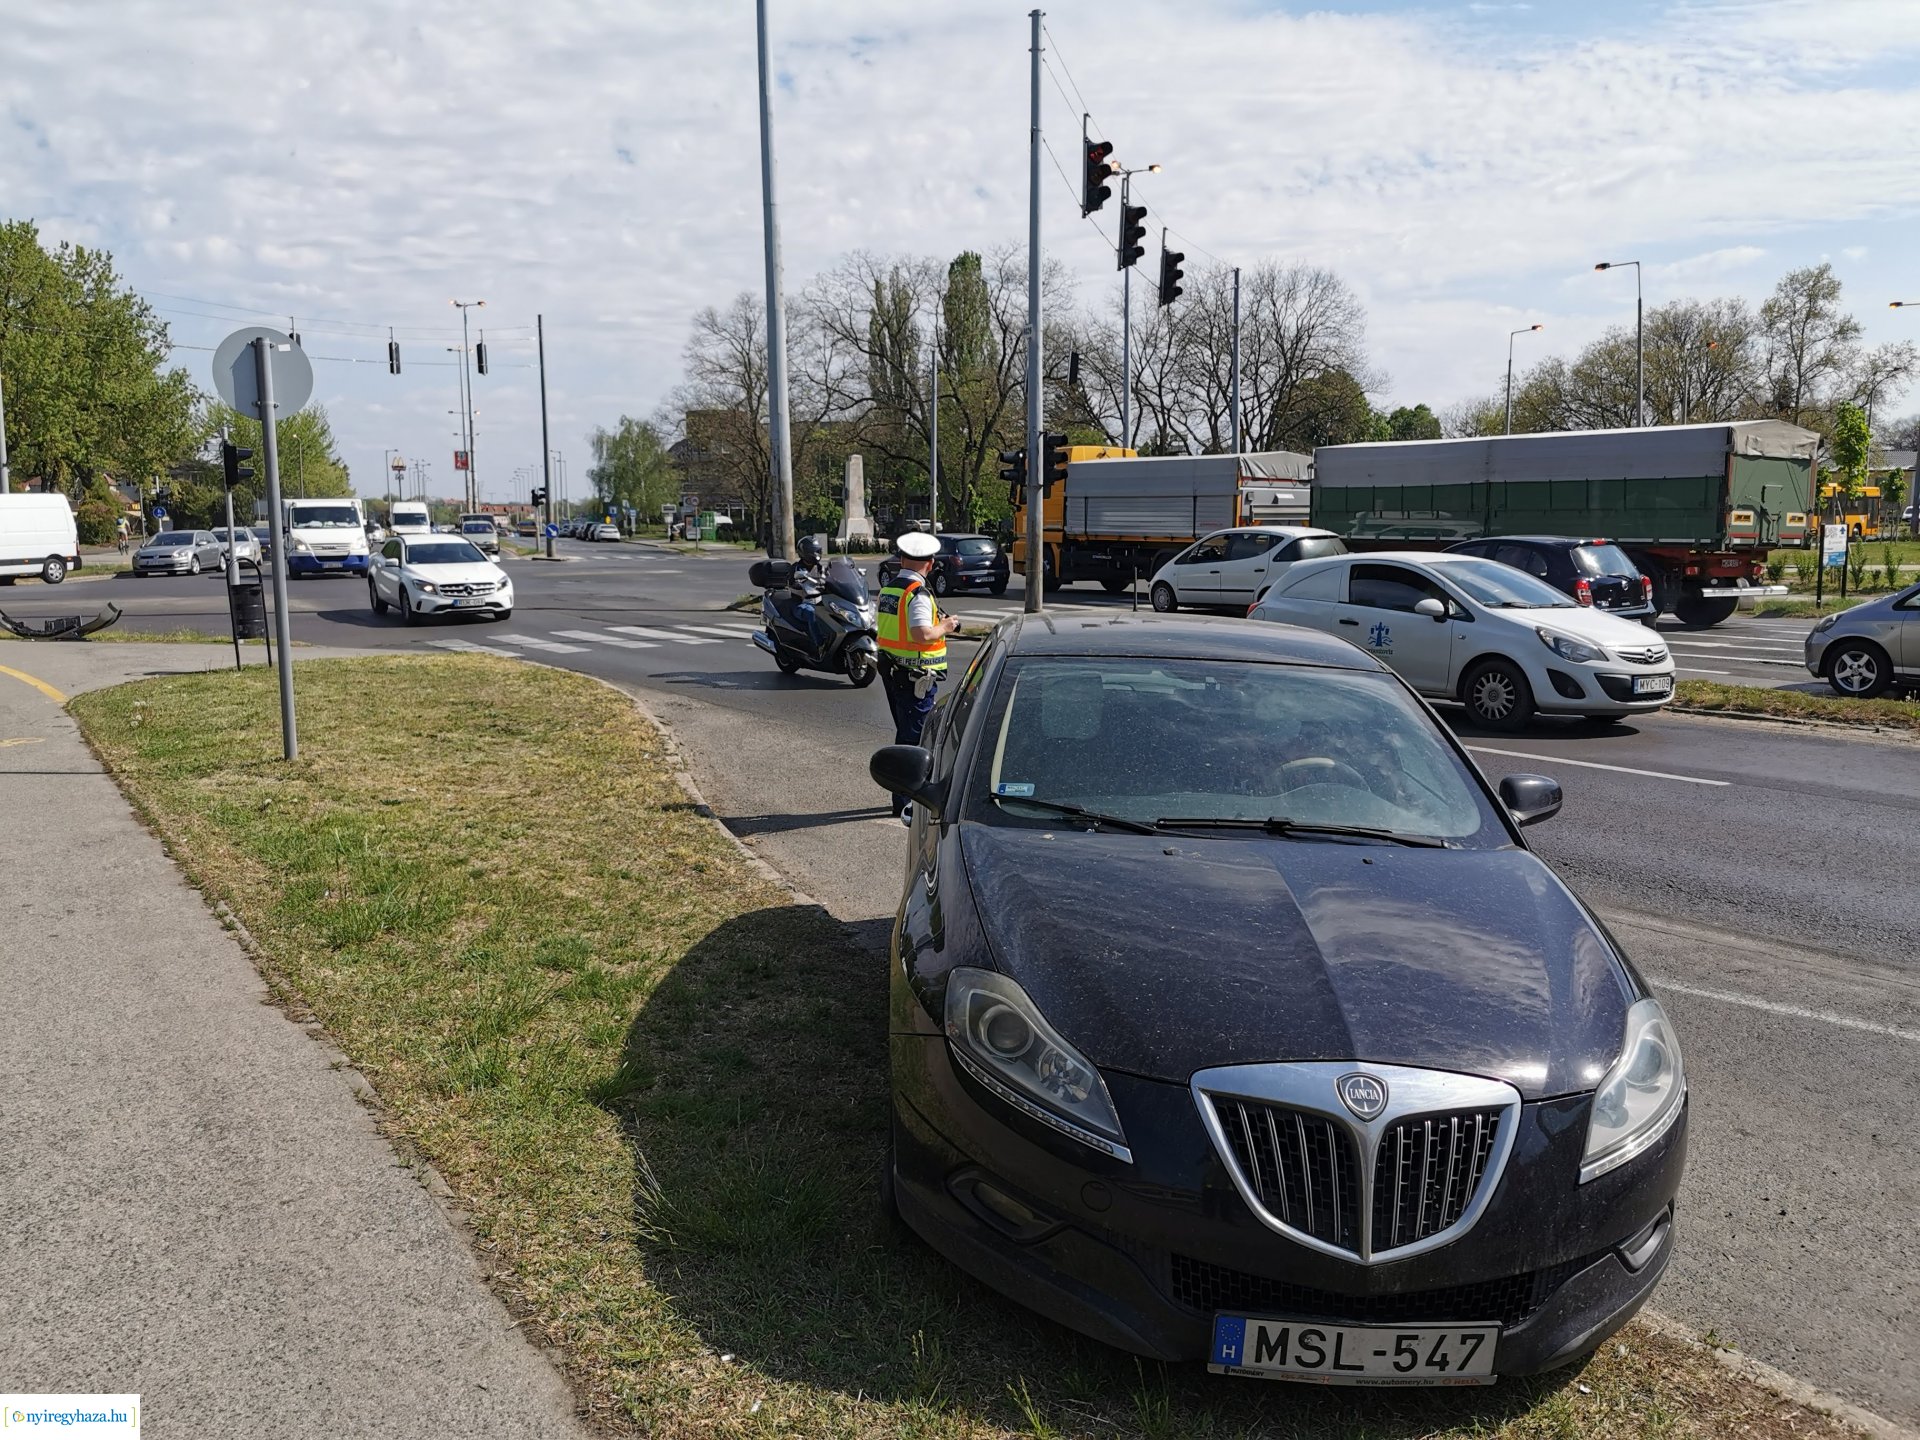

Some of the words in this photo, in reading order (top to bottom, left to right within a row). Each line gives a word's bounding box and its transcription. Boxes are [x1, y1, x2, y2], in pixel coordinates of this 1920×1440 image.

[1640, 678, 1669, 690] MYC-109
[1350, 1089, 1379, 1100] LANCIA
[1222, 1344, 1236, 1359] H
[1254, 1325, 1486, 1373] MSL-547
[1355, 1378, 1435, 1386] www.automery.hu
